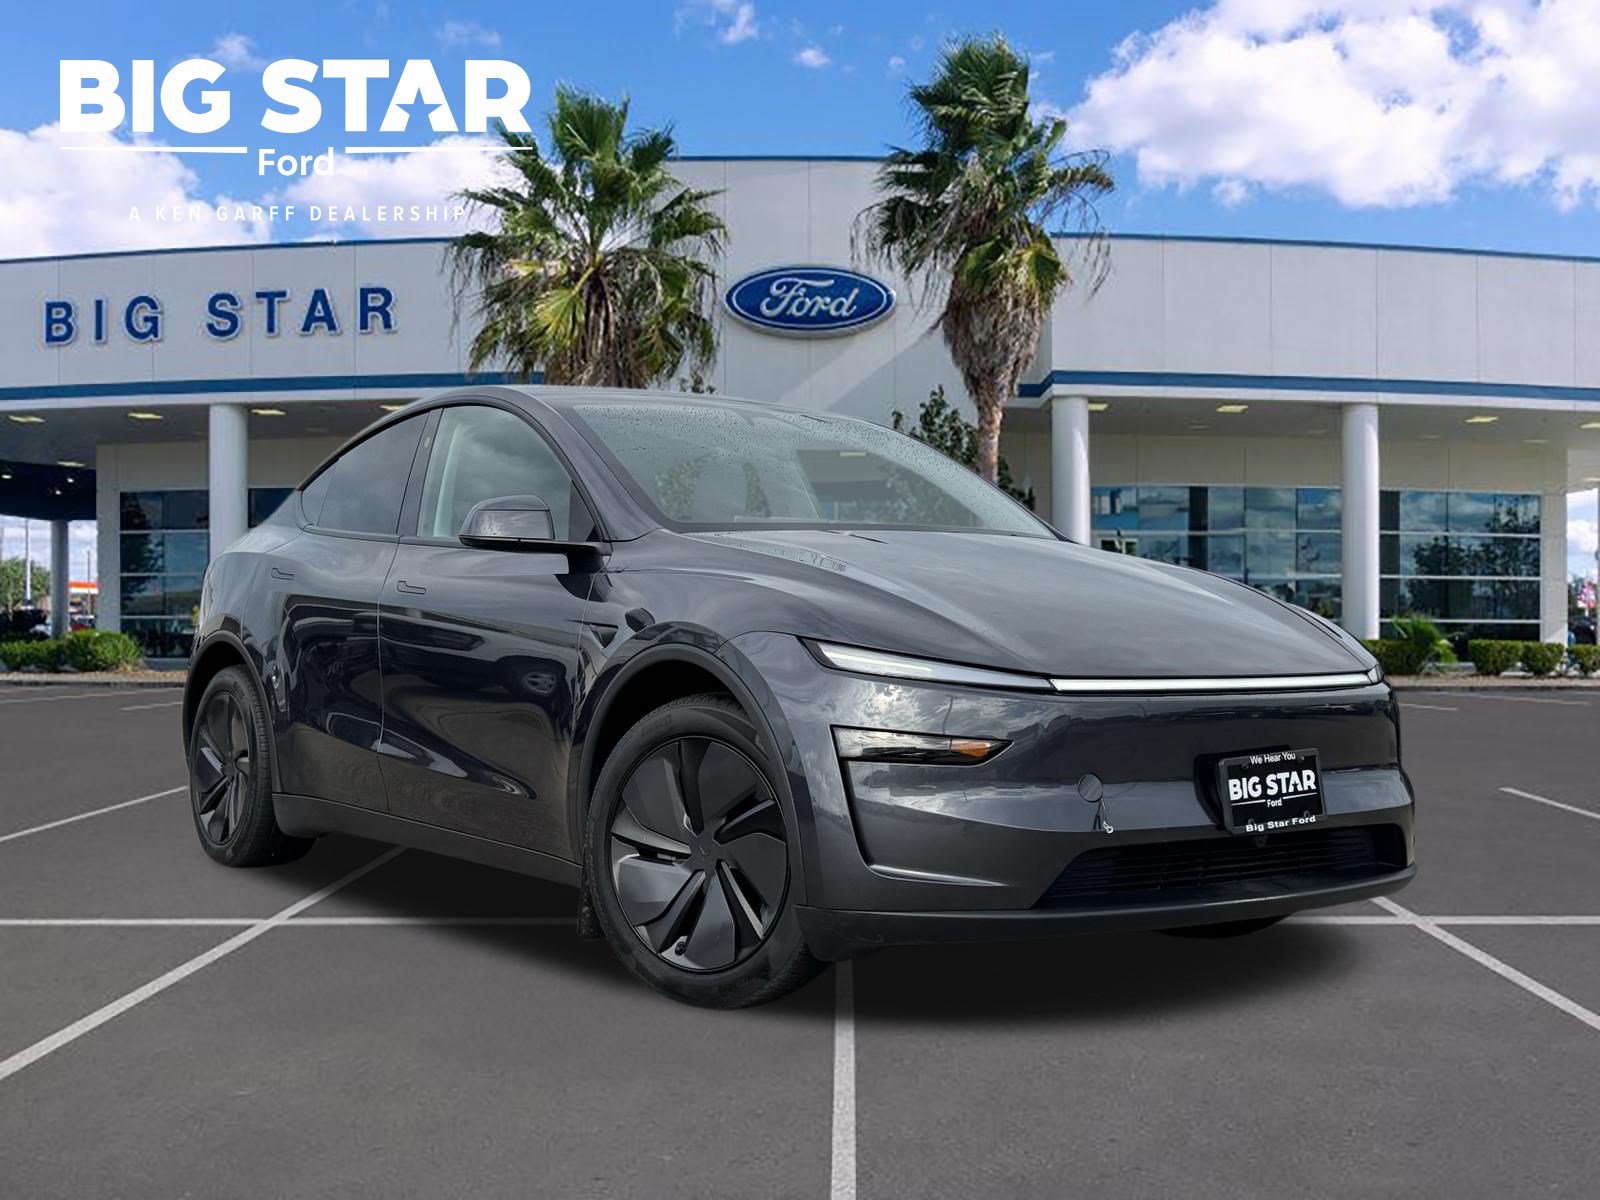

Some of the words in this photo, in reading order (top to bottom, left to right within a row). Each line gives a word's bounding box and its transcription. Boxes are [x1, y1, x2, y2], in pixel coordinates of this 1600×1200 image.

[760, 277, 860, 318] Ford
[43, 294, 164, 346] BIG
[204, 285, 400, 339] STAR
[1250, 755, 1263, 765] We
[1264, 753, 1281, 763] Hear
[1282, 752, 1296, 761] You
[1228, 776, 1262, 801] BIG
[1266, 769, 1317, 796] STAR
[1267, 798, 1283, 808] Ford
[1245, 822, 1265, 832] Big
[1267, 819, 1291, 829] Star
[1292, 815, 1317, 825] Ford
